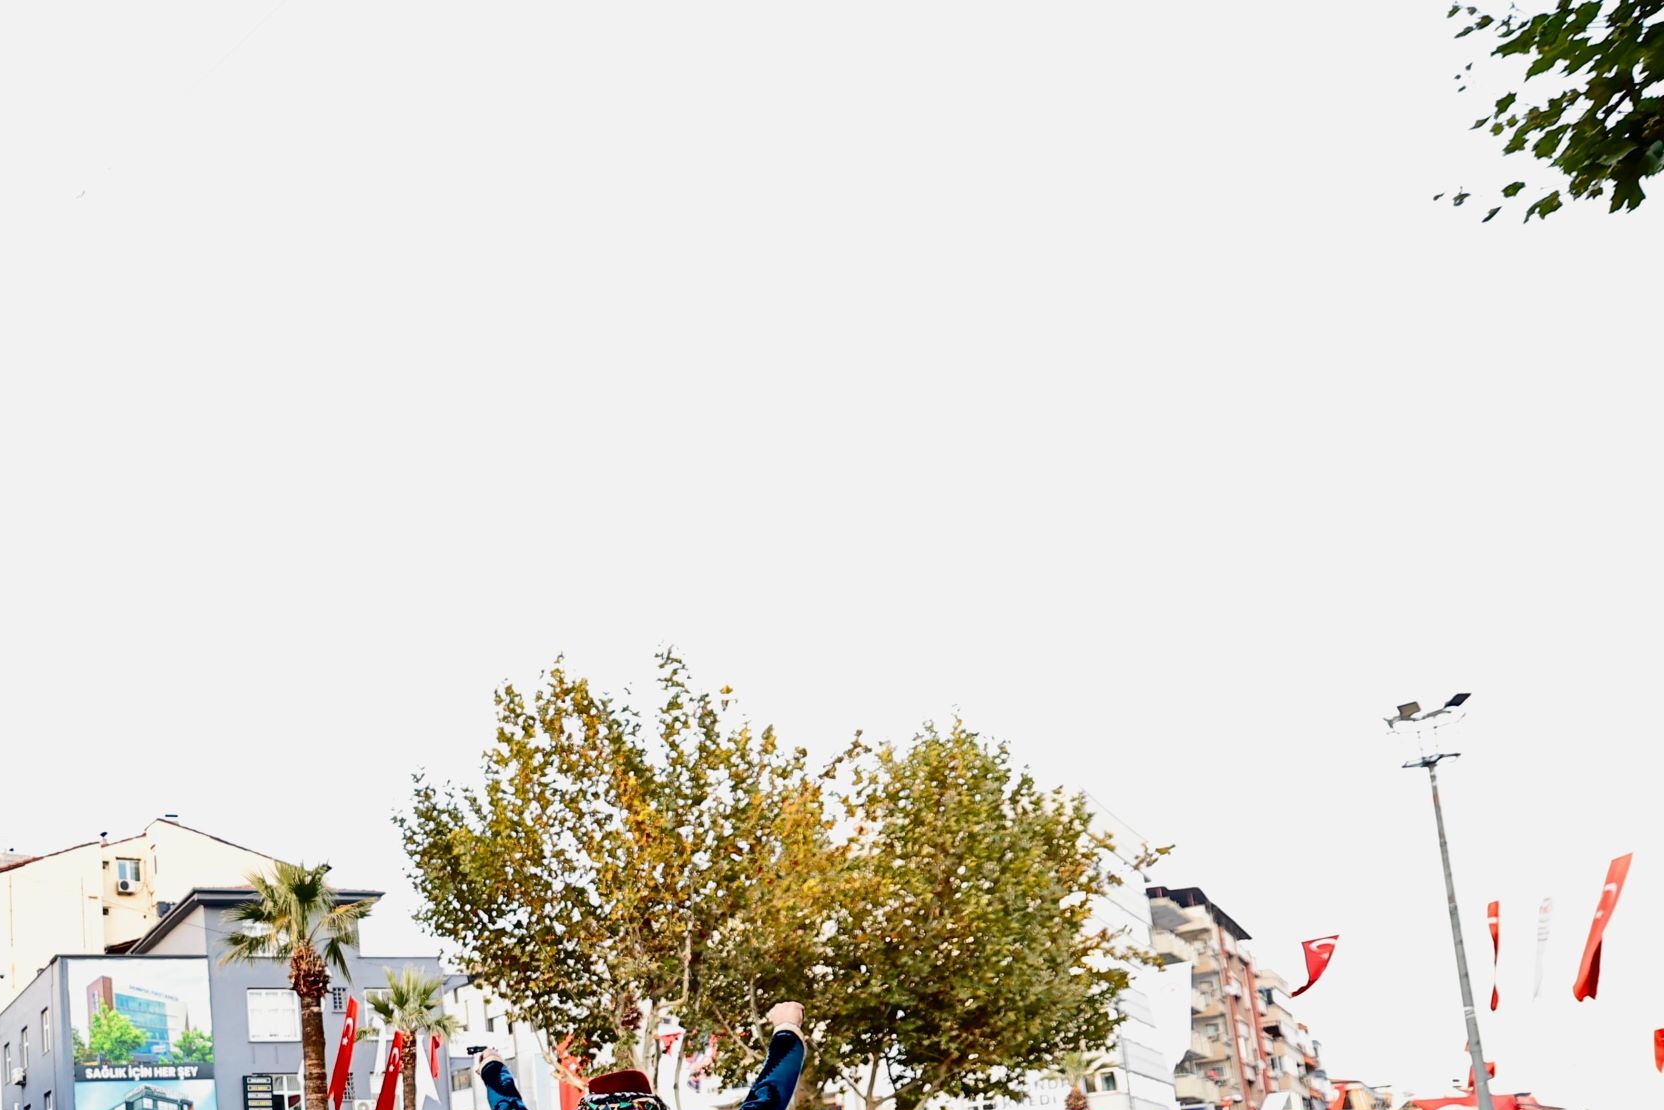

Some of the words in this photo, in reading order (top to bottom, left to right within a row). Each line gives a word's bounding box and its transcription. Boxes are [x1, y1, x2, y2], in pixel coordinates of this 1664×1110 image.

[85, 1064, 127, 1079] SAĞLIK
[128, 1064, 153, 1081] İÇİN
[154, 1066, 176, 1078] HER
[177, 1065, 199, 1081] ŞEY
